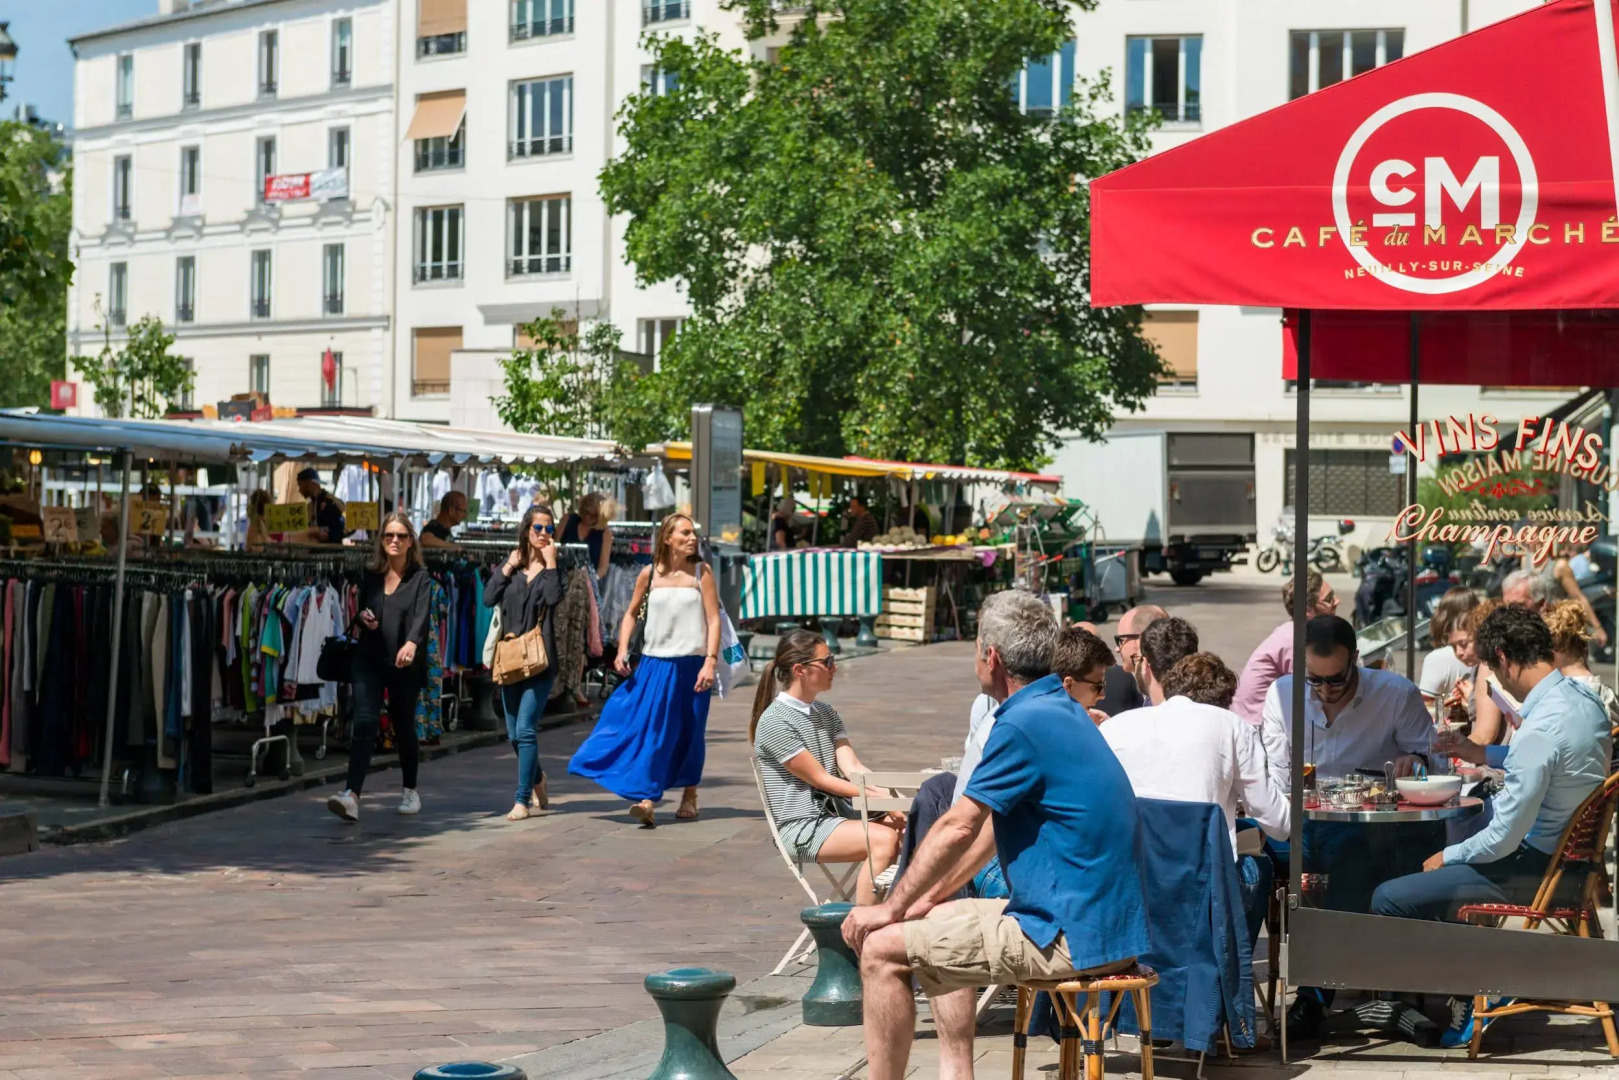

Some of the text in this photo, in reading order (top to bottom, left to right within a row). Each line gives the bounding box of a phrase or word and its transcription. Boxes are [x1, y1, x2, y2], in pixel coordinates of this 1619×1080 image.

[1250, 215, 1619, 249] CAFÉ du MARCHÉ
[1343, 260, 1526, 280] NEUILLY-SUR-SEINE
[1392, 413, 1603, 471] VINS FINS
[1384, 503, 1600, 566] Champagne
